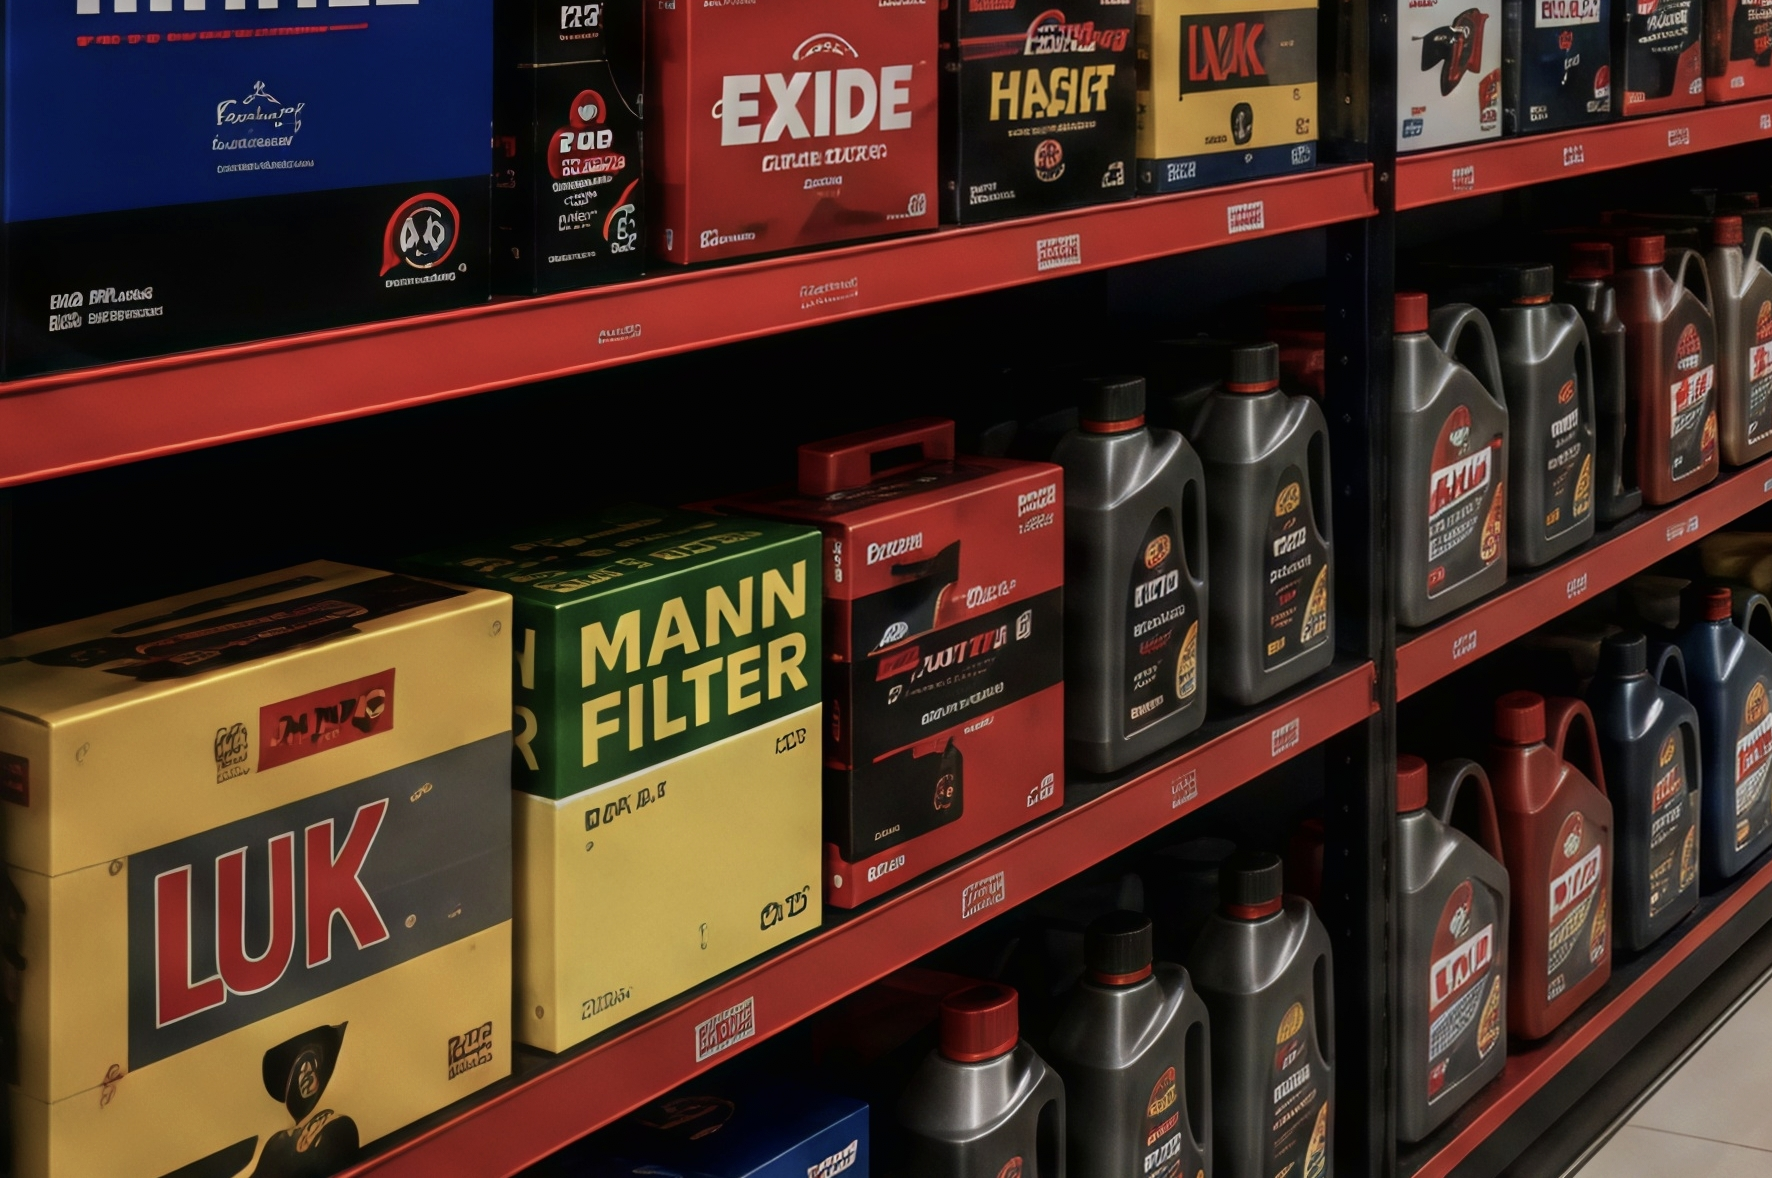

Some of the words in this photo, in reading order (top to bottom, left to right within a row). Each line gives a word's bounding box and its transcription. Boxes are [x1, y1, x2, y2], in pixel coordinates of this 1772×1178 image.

[720, 64, 914, 147] EXIDE
[581, 559, 807, 689] MANN
[581, 630, 809, 769] FILTER
[155, 797, 391, 1029] LUK
